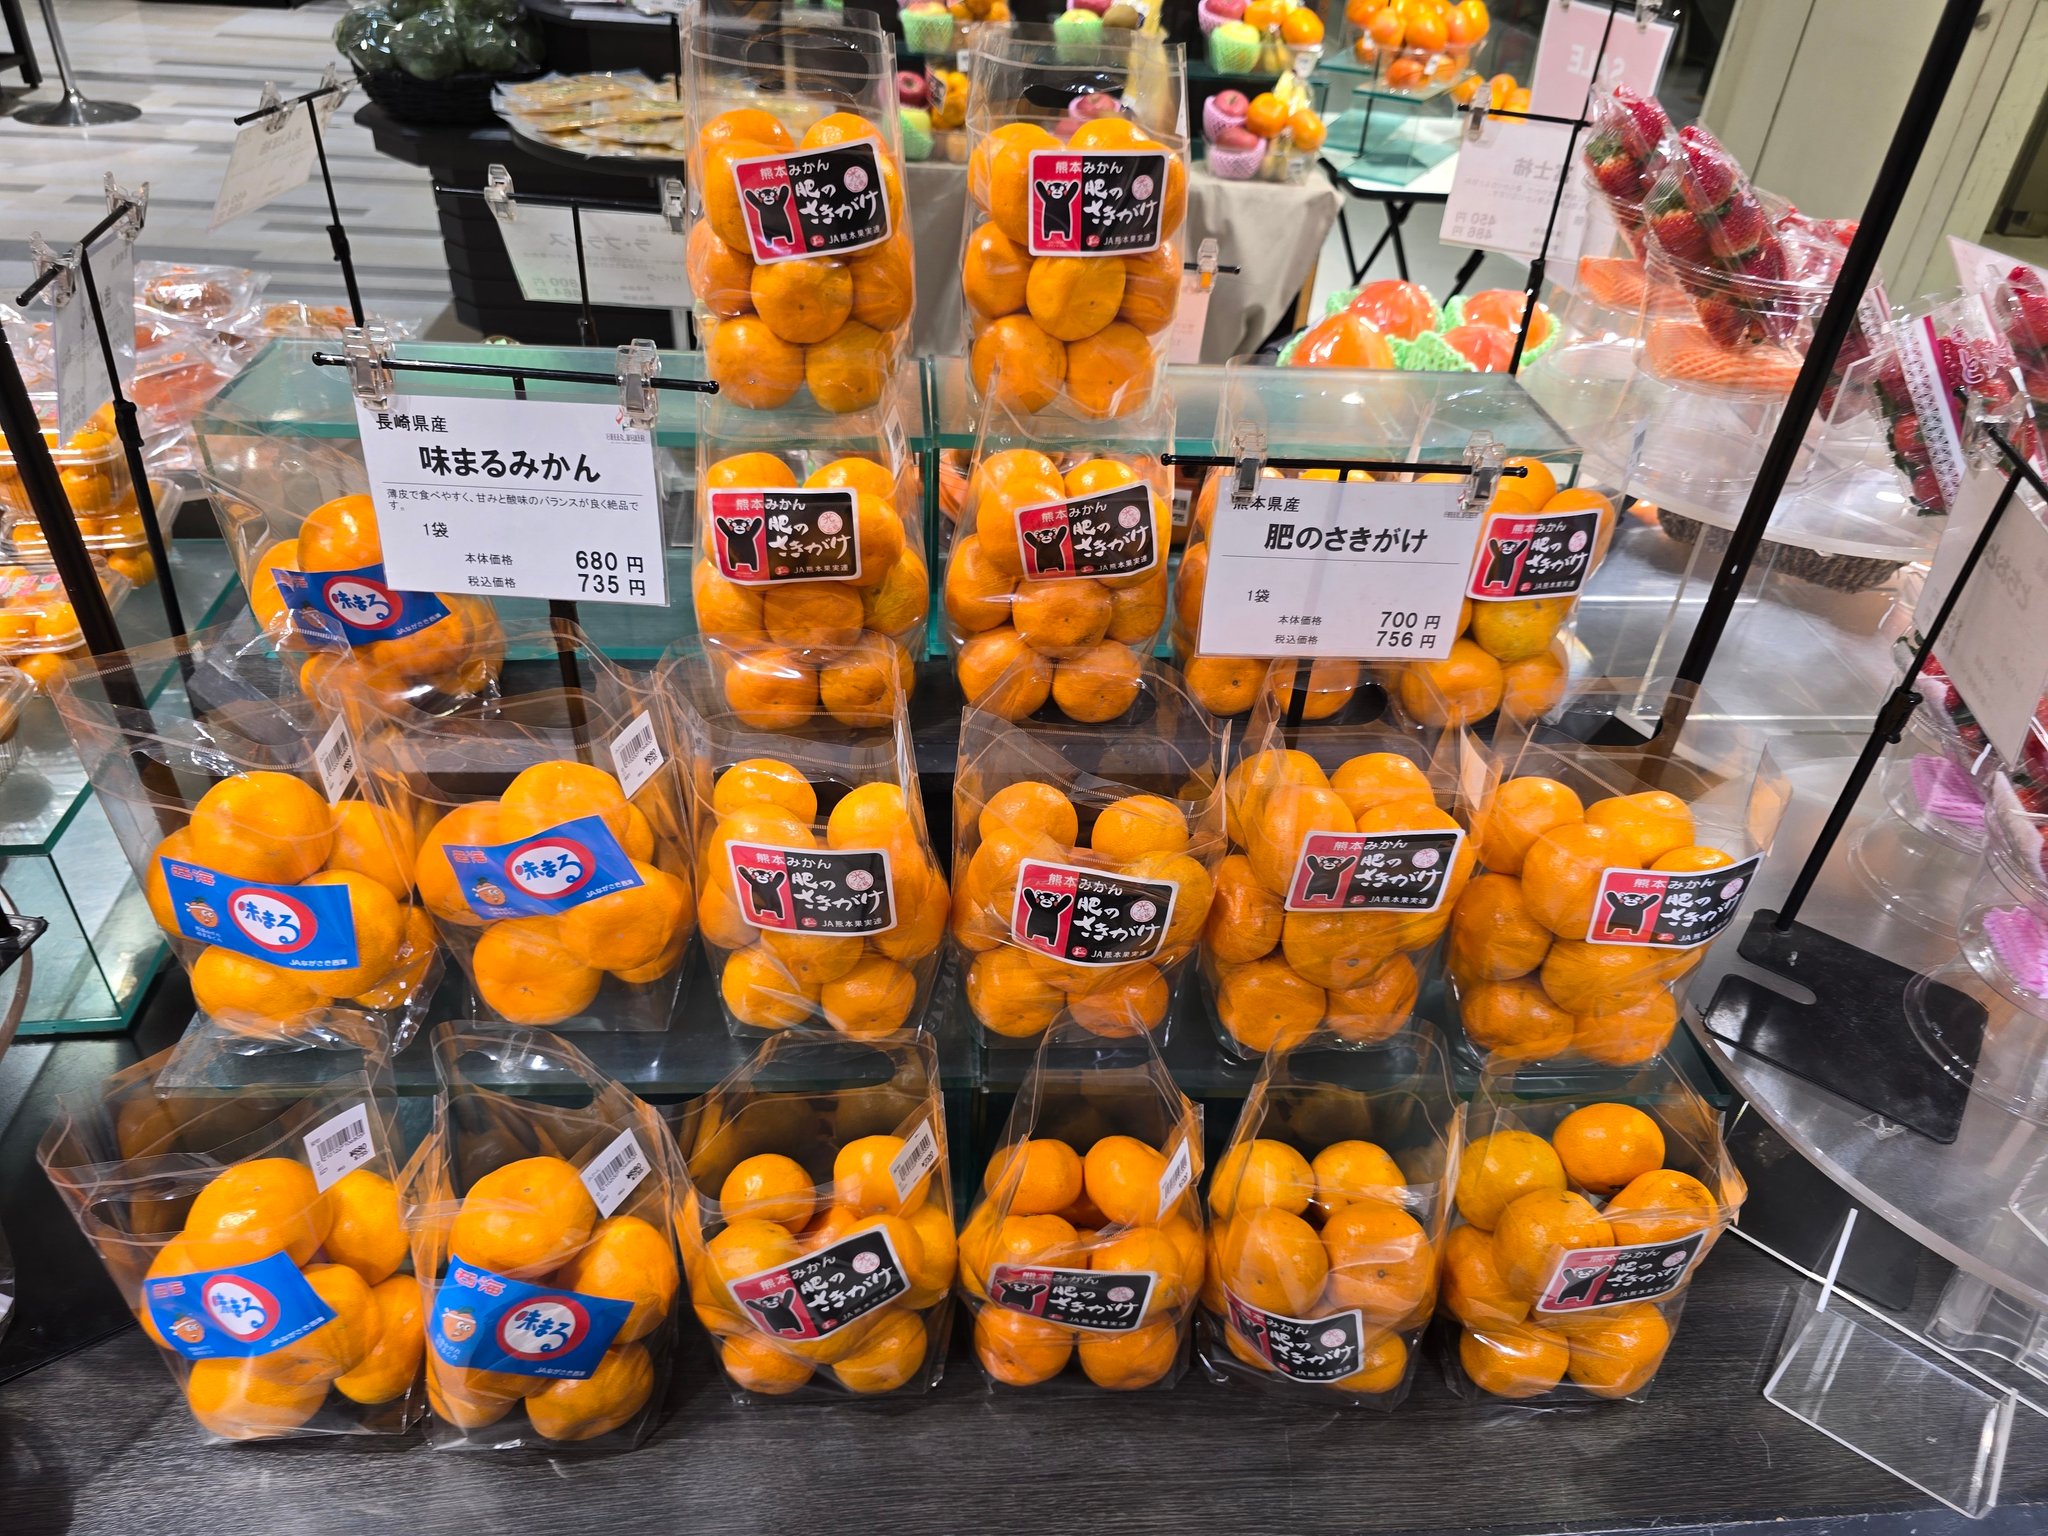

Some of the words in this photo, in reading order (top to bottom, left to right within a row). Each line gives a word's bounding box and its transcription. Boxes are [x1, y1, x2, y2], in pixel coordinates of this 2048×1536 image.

[759, 159, 830, 181] 熊本みかん
[1055, 161, 1124, 175] 熊本みかん
[795, 179, 836, 199] 肥の
[1084, 179, 1123, 201] 肥の
[799, 190, 879, 225] さきがけ
[1083, 199, 1158, 229] さきがけ
[376, 413, 448, 433] 長崎県産
[419, 445, 600, 482] 味まるみかん
[387, 488, 639, 511] 薄皮で食べやすく、甘みと酸味のバランスが良く絶品で
[735, 498, 806, 511] 熊本みかん
[1041, 501, 1107, 523] 熊本みかん
[422, 522, 449, 538] 1袋
[768, 514, 809, 536] 肥の
[1072, 519, 1111, 536] 肥の
[1512, 521, 1566, 535] 熊本みかん
[768, 534, 852, 560] さきがけ
[1074, 525, 1149, 557] さきがけ
[1264, 523, 1428, 554] 肥のさきがけ
[1530, 536, 1562, 553] 肥の
[465, 553, 513, 566] 本体価格
[575, 551, 618, 571] 680
[627, 556, 644, 574] 円
[1525, 552, 1588, 576] さきがけ
[468, 576, 516, 589] 税込価格
[578, 574, 619, 593] 735
[629, 579, 646, 597] 円
[1247, 589, 1270, 603] 1袋
[331, 590, 393, 620] 味まる
[1278, 615, 1322, 626] 本体価格
[1380, 611, 1419, 630] 700
[1424, 615, 1440, 630] 円
[1274, 634, 1318, 645] 税込価格
[1375, 631, 1413, 648] 756
[1420, 634, 1436, 649] 円
[1333, 839, 1408, 851] 熊本みかん
[514, 853, 584, 884] 味まる
[756, 852, 832, 870] 熊本みかん
[1360, 853, 1402, 868] 肥の
[791, 872, 836, 891] 肥の
[1048, 873, 1123, 896] 熊本みかん
[1354, 868, 1443, 893] さきがけ
[1633, 877, 1716, 889] 熊本みかん
[793, 889, 884, 915] さきがけ
[1077, 897, 1120, 919] 肥の
[1665, 892, 1711, 908] 肥の
[237, 900, 300, 945] 味まる
[822, 918, 882, 928] JA熊本果実連
[1073, 915, 1161, 947] さきがけ
[454, 1267, 506, 1297] 西海
[759, 1255, 837, 1291] 熊本みかん
[800, 1272, 846, 1295] 肥の
[806, 1266, 893, 1312] さきがけ
[1053, 1285, 1097, 1299] 肥の
[1049, 1297, 1139, 1319] さきがけ
[514, 1309, 571, 1353] 味まる
[1271, 1343, 1356, 1365] さきがけ
